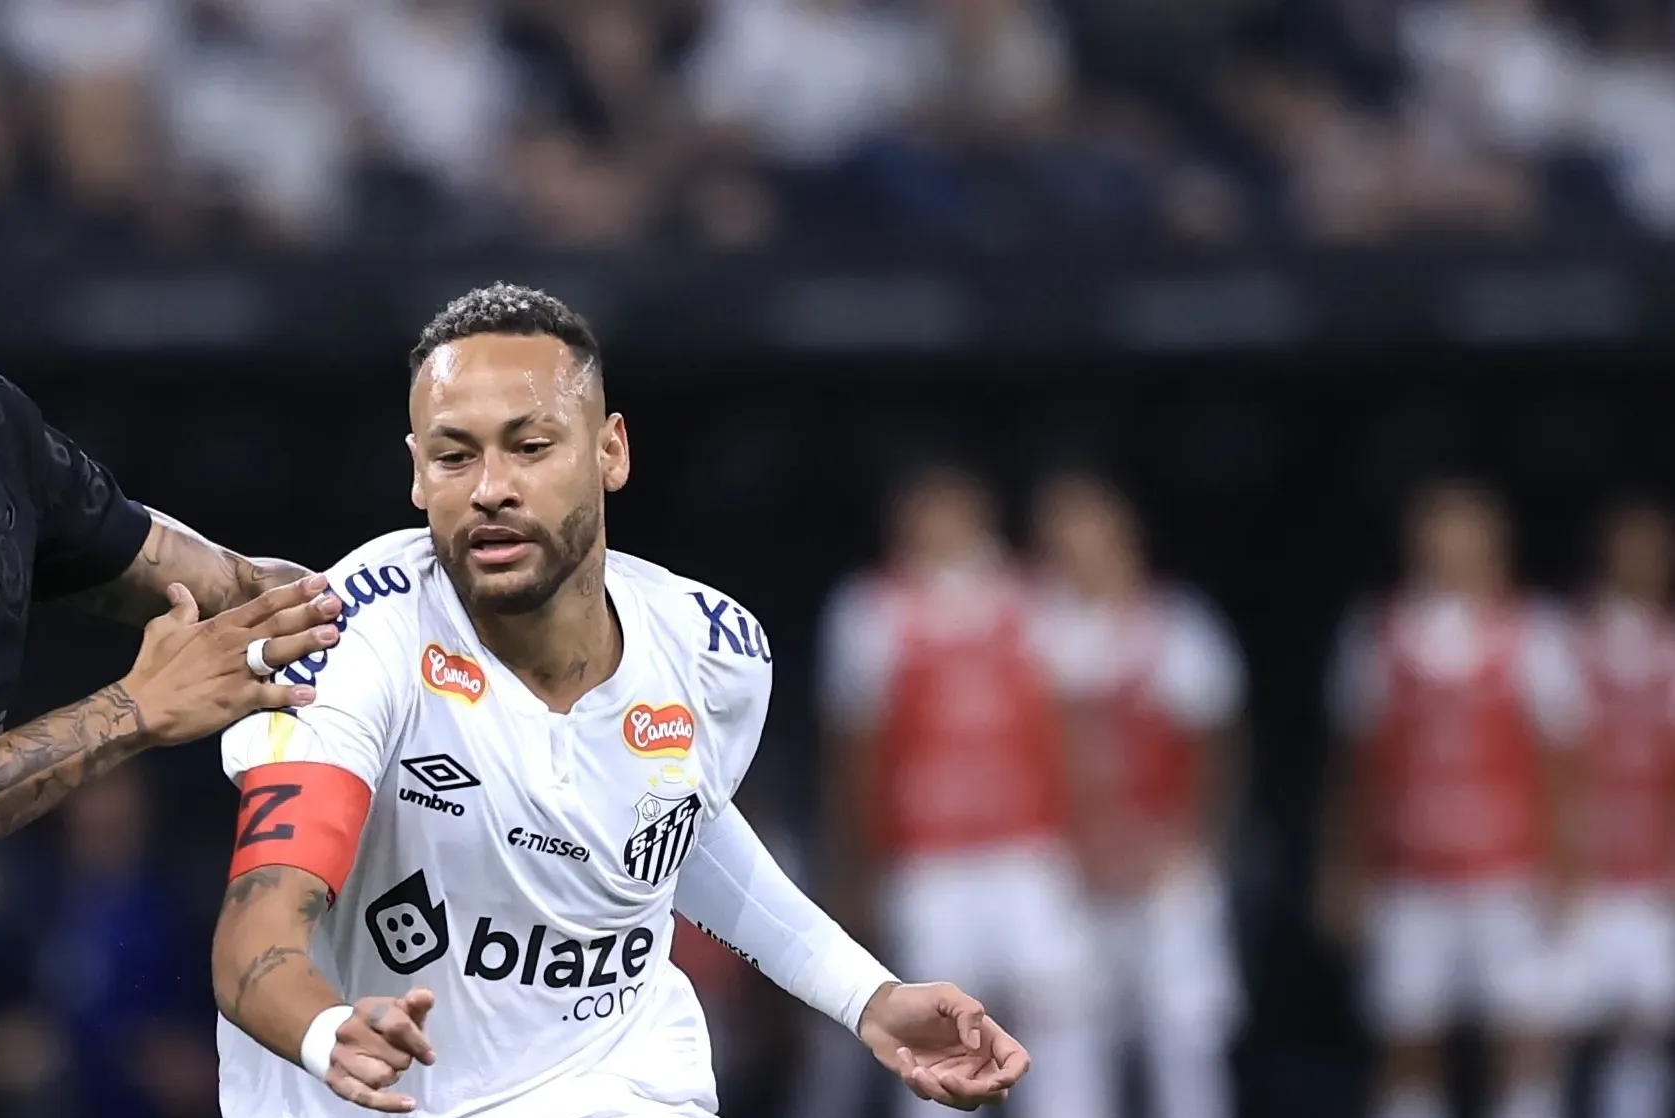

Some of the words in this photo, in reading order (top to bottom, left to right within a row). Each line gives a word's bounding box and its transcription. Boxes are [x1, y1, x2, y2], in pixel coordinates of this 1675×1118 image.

[630, 710, 693, 747] Canção
[399, 787, 465, 817] umbro
[464, 916, 654, 989] blaze
